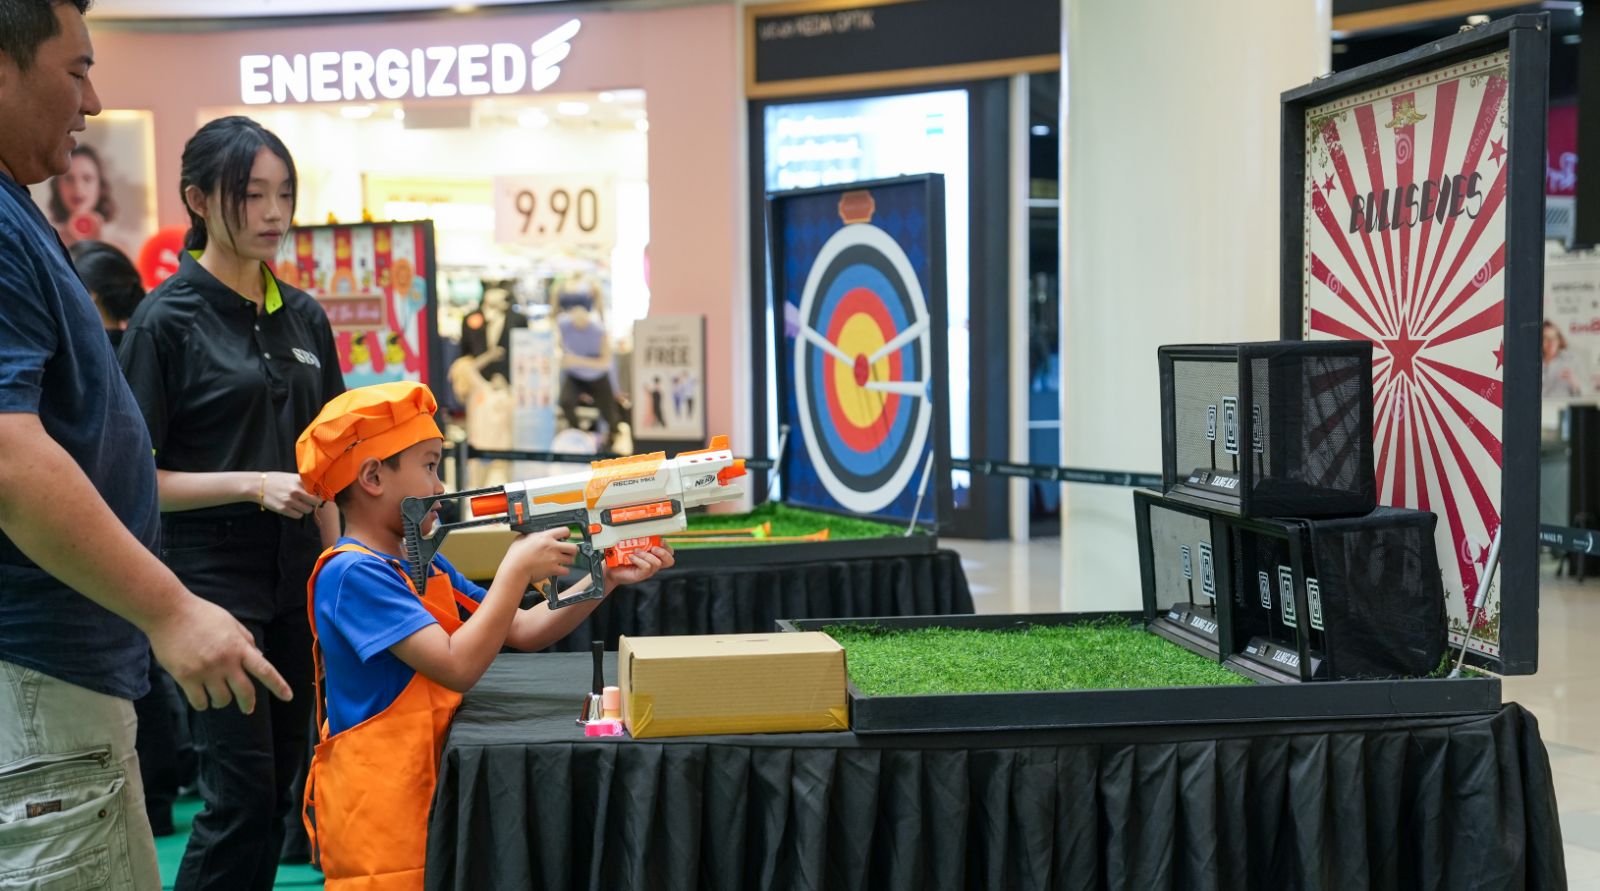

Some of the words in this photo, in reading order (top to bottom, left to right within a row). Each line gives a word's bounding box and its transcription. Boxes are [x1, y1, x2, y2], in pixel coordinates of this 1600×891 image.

[240, 43, 527, 105] ENERGIZED
[515, 188, 598, 234] 9.90
[1349, 171, 1482, 234] BULLSEYES
[644, 345, 690, 367] FREE
[612, 479, 639, 487] RECON
[1272, 649, 1291, 663] YANG
